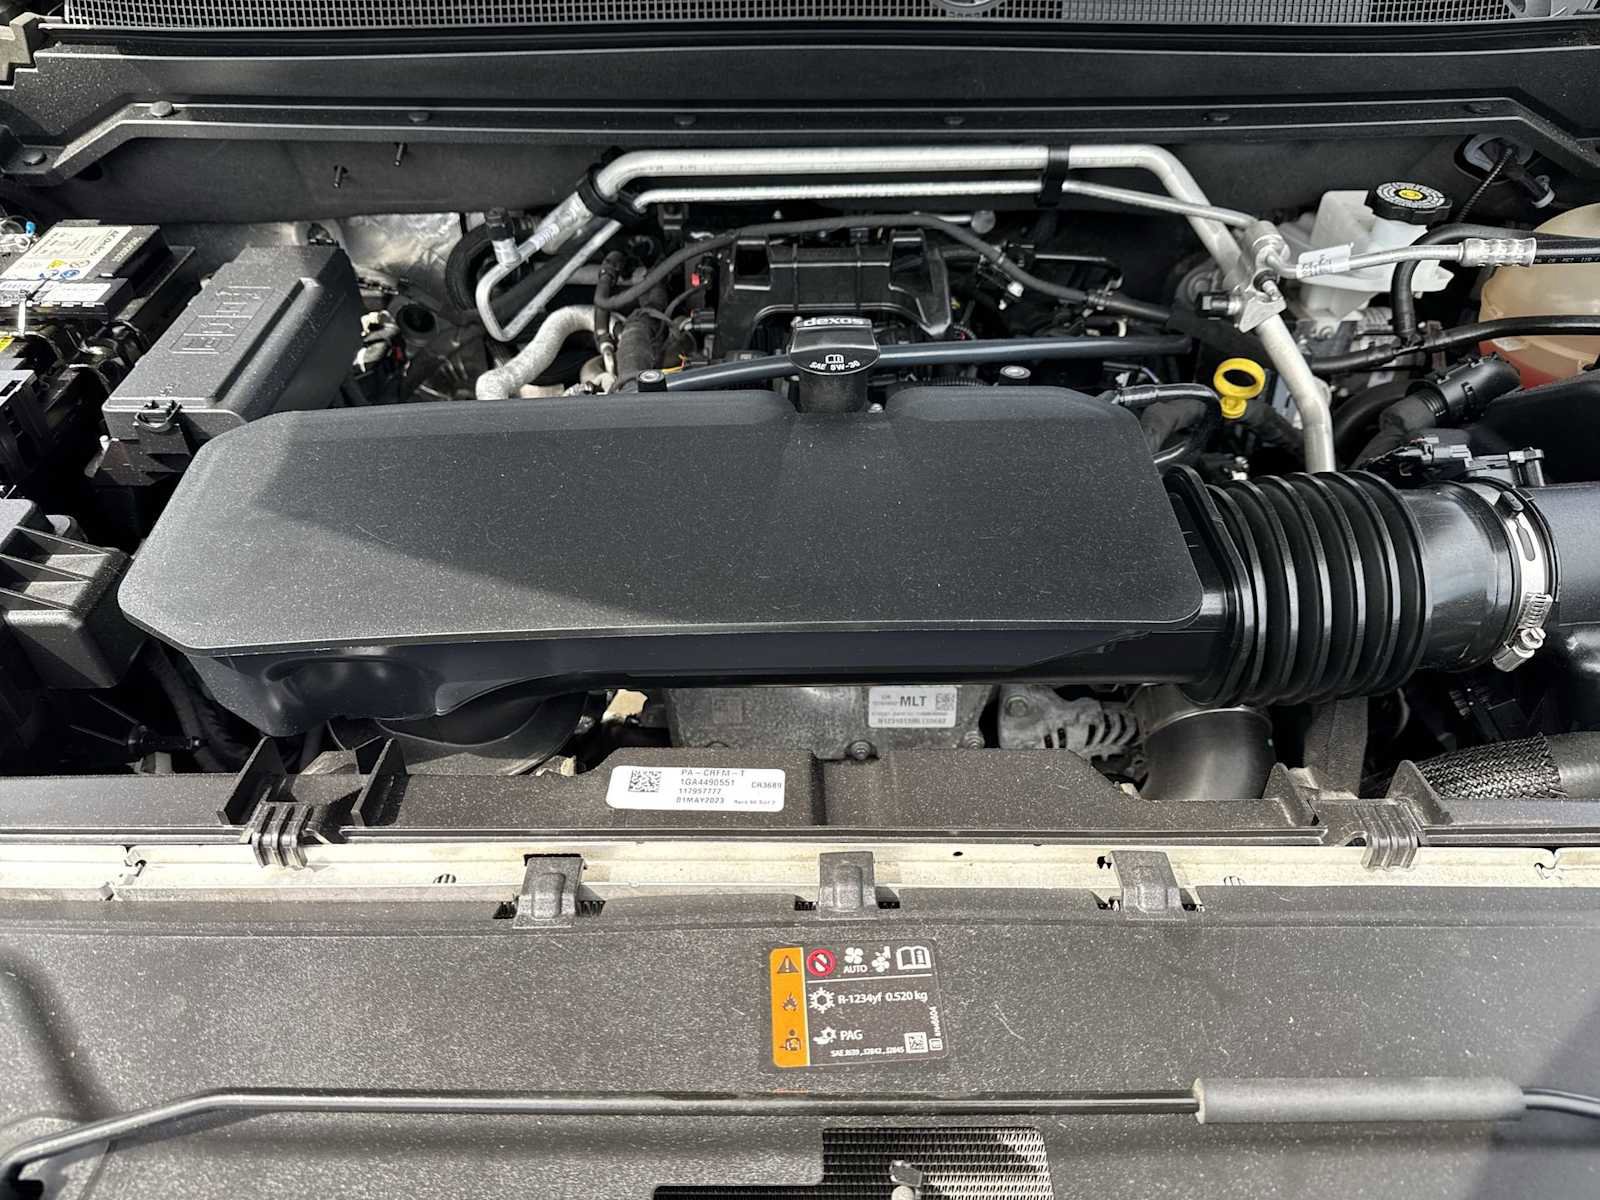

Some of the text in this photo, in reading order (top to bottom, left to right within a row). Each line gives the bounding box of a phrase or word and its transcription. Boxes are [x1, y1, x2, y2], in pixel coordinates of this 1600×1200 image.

[803, 317, 865, 327] dexos
[809, 361, 827, 371] SAE
[900, 695, 927, 707] MLT
[843, 964, 868, 973] AUTO
[837, 990, 928, 1005] R-1234yf 0.520 kg
[840, 1030, 863, 1041] PAG
